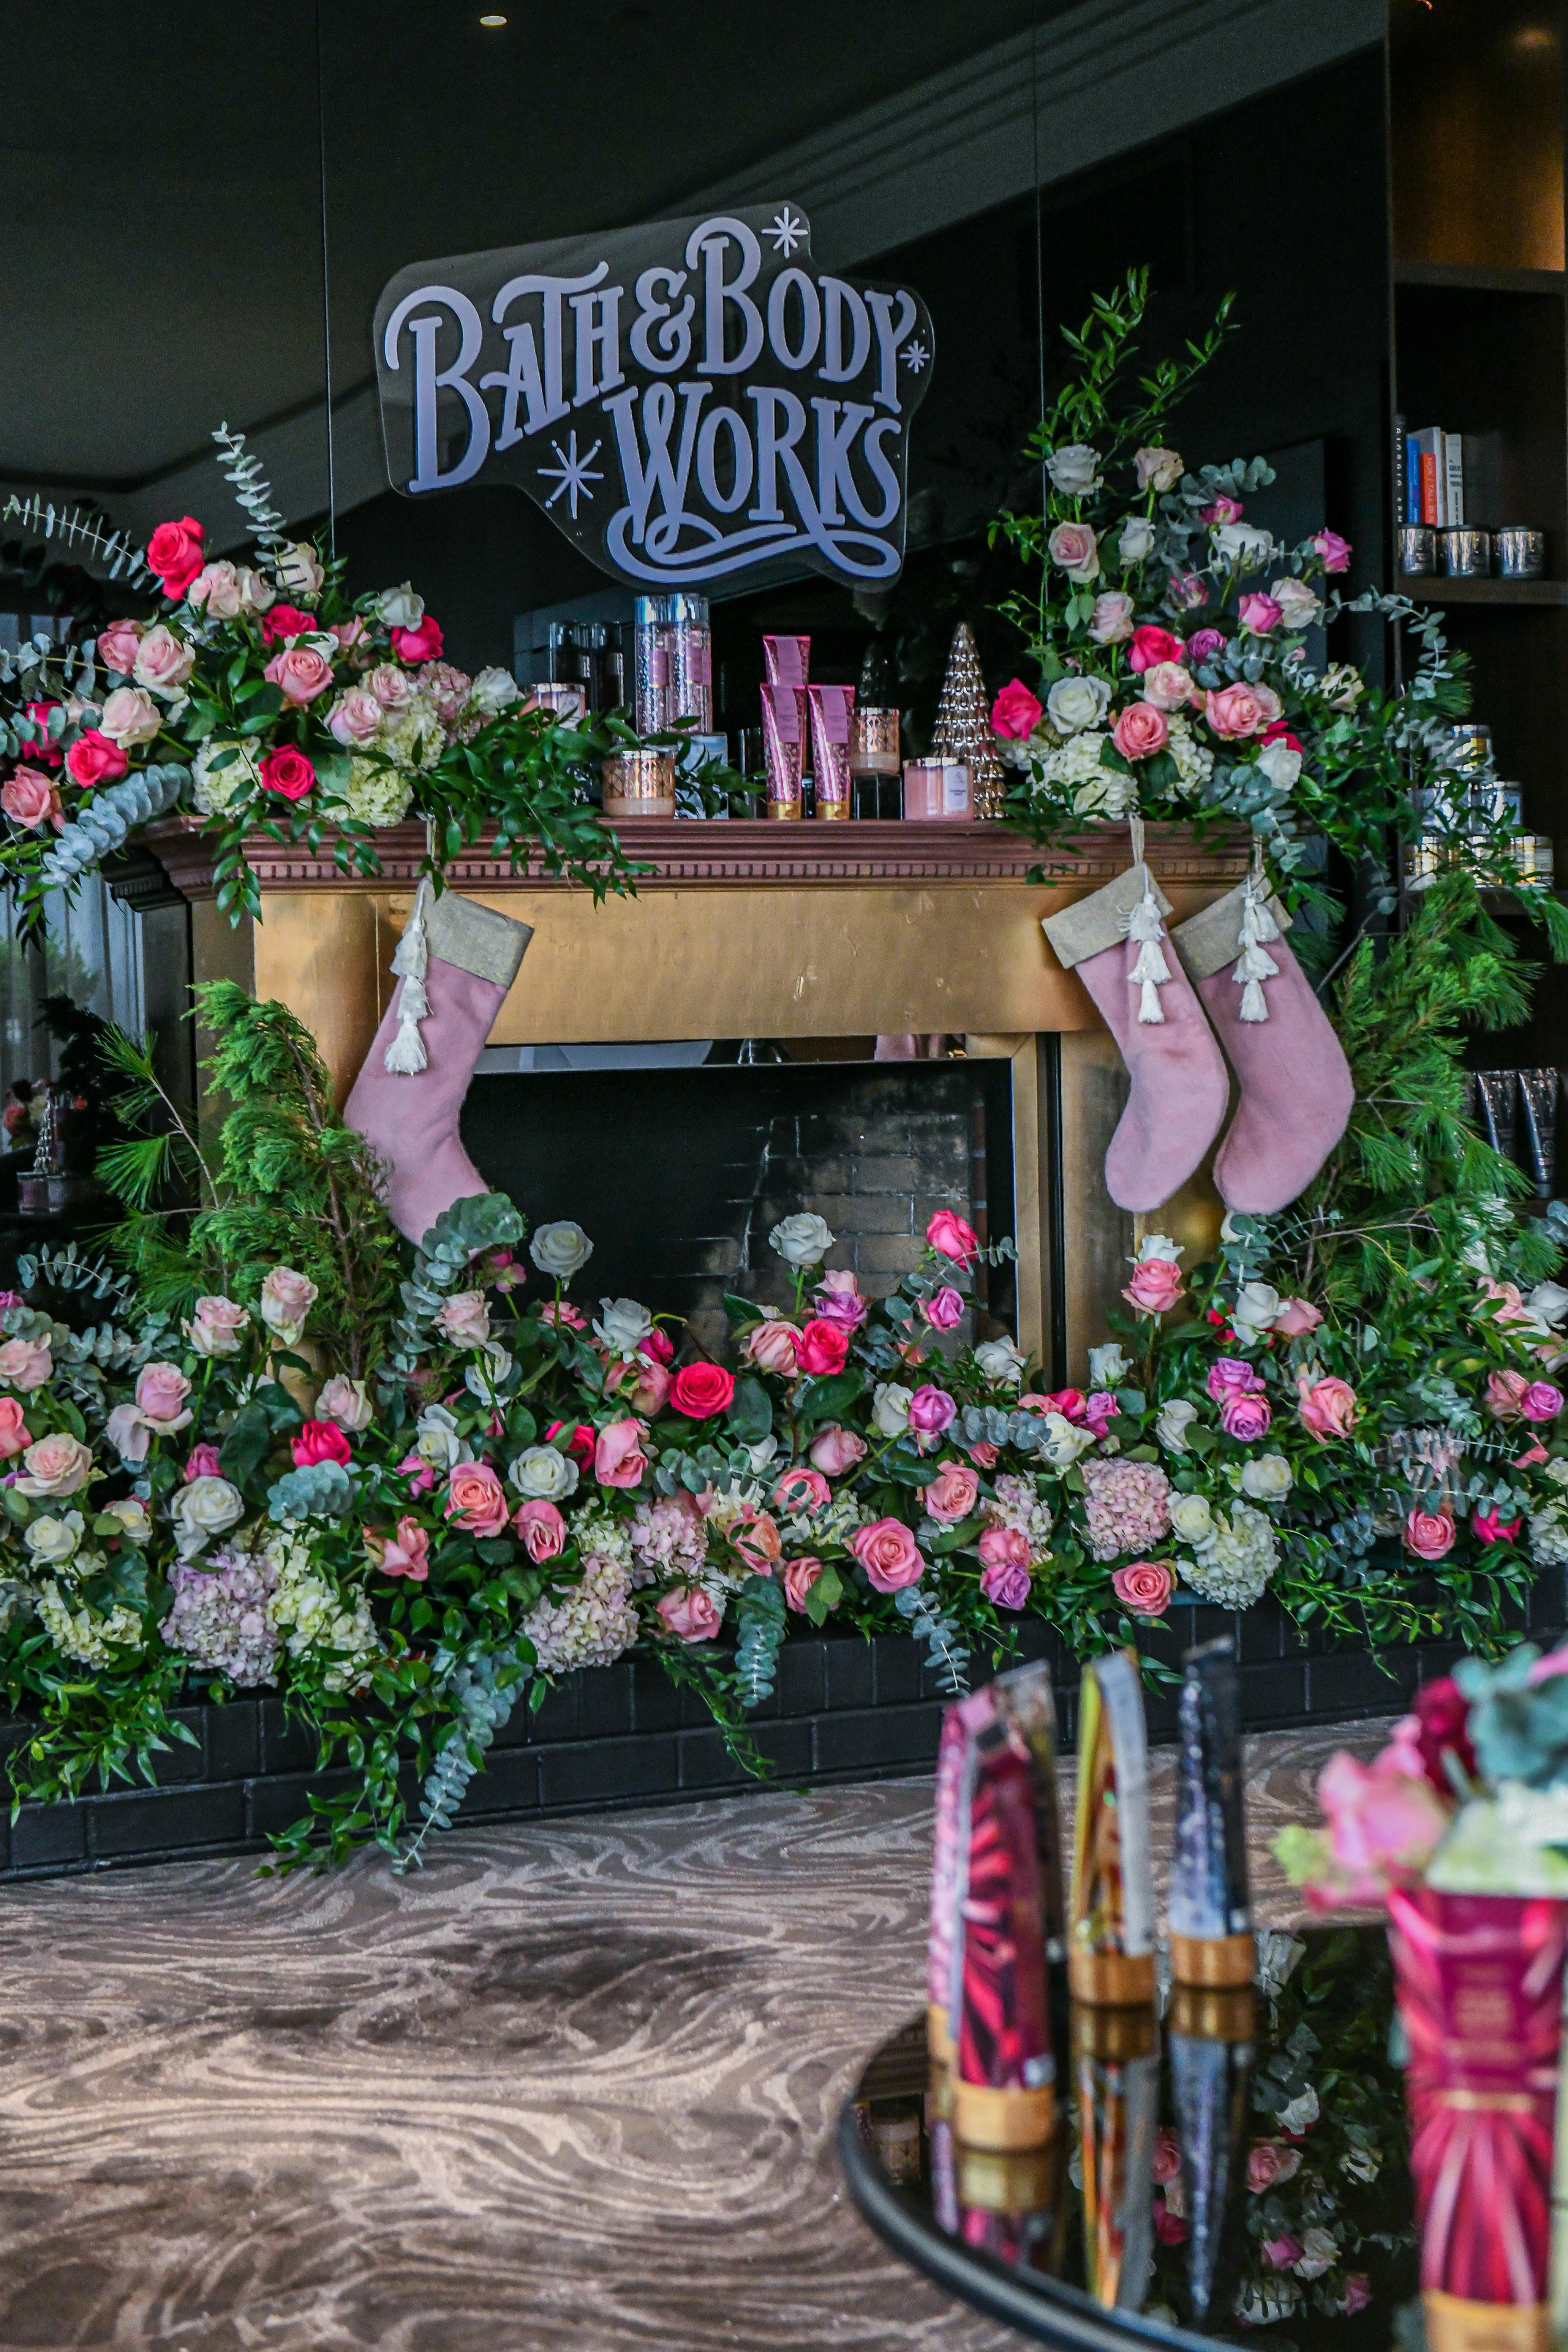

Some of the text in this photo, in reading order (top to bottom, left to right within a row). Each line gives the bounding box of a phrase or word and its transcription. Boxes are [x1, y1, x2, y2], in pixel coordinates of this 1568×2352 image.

[384, 217, 917, 493] BATH & BODY
[602, 382, 902, 583] WORKS
